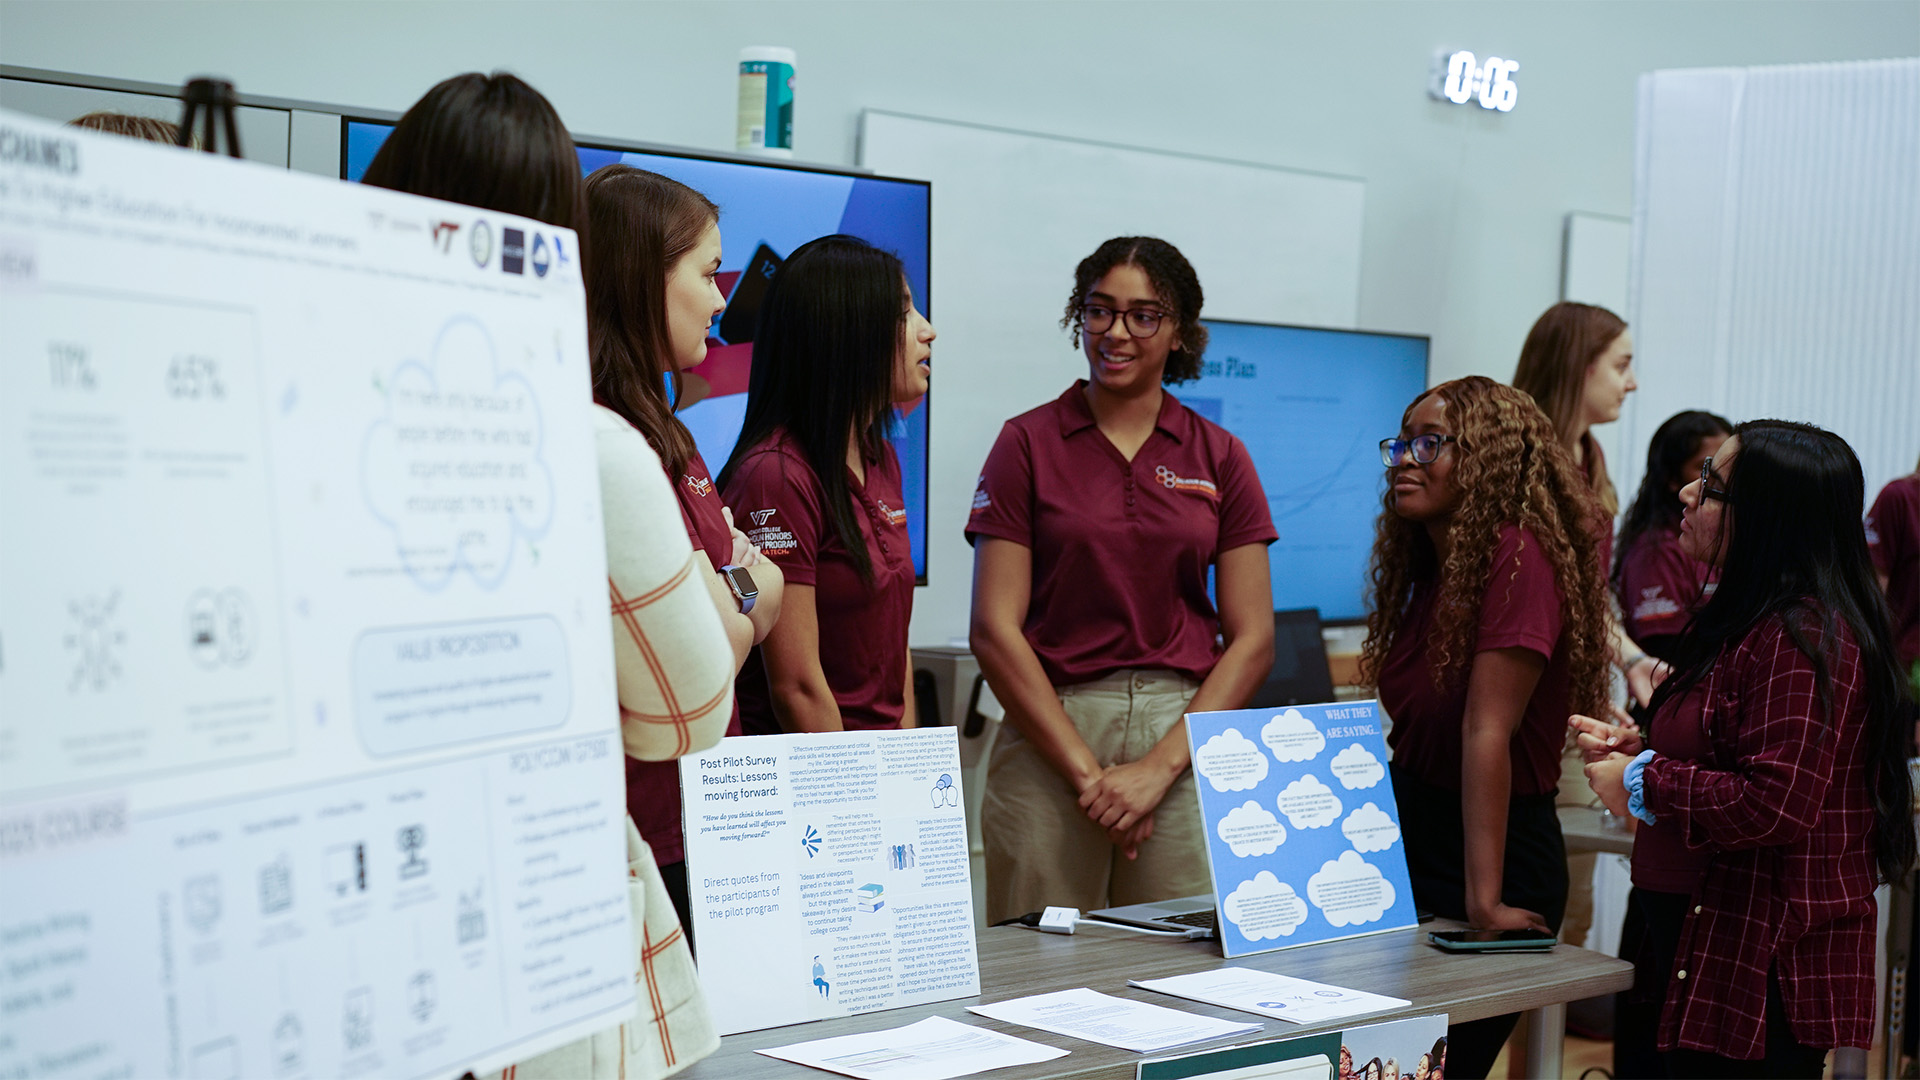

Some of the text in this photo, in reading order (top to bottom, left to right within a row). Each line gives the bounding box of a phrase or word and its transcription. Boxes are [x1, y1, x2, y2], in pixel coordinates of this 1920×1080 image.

[1444, 50, 1520, 112] 10:06
[761, 260, 776, 279] 12
[750, 509, 776, 526] VT
[765, 531, 792, 540] HONORS
[765, 540, 797, 549] PROGRAM
[1325, 705, 1372, 720] WHAT THEY
[1326, 727, 1343, 739] ARE
[701, 756, 776, 768] Post Pilot Survey
[703, 773, 777, 784] Results: Lessons
[705, 786, 778, 801] moving forward:
[727, 822, 748, 830] learned
[761, 820, 775, 828] affect
[704, 872, 779, 888] Direct quotes from
[800, 883, 817, 891] gained
[706, 886, 780, 903] the participants of
[828, 898, 848, 906] greatest
[709, 904, 779, 919] the pilot program
[893, 931, 915, 939] obligated
[900, 971, 917, 979] opened
